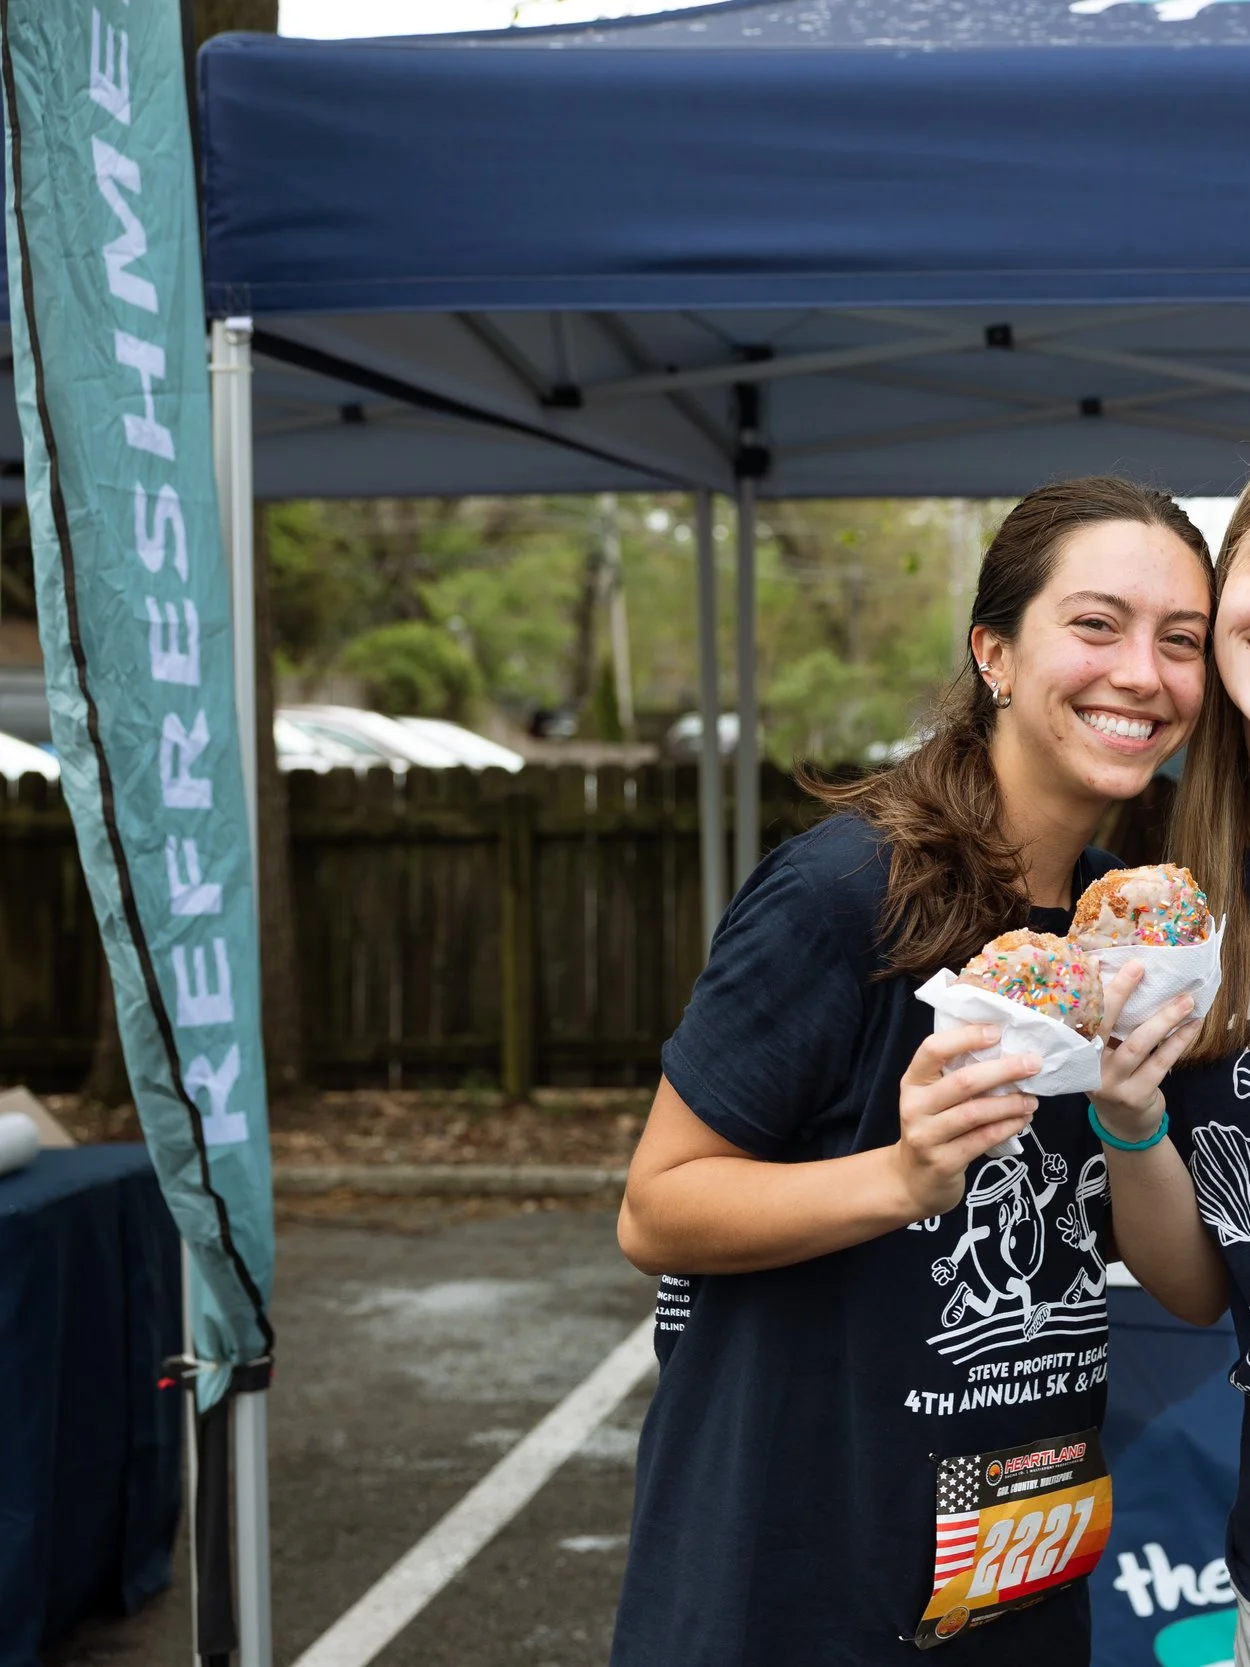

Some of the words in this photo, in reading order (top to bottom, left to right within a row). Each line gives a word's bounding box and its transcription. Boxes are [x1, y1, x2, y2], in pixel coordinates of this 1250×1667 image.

[89, 0, 249, 1147] REFRESHME
[661, 1274, 691, 1287] CHURCH
[660, 1321, 686, 1332] BLIND
[904, 1389, 955, 1416] 4TH
[958, 1378, 1042, 1414] ANNUAL
[1045, 1372, 1071, 1397] 5K
[1074, 1371, 1090, 1393] &
[1088, 1361, 1108, 1388] FU
[967, 1362, 1010, 1383] STEVE
[1013, 1352, 1076, 1377] PROFFITT
[1004, 1442, 1087, 1475] HEARTLAND
[965, 1495, 1095, 1600] 2227
[1112, 1541, 1237, 1617] the
